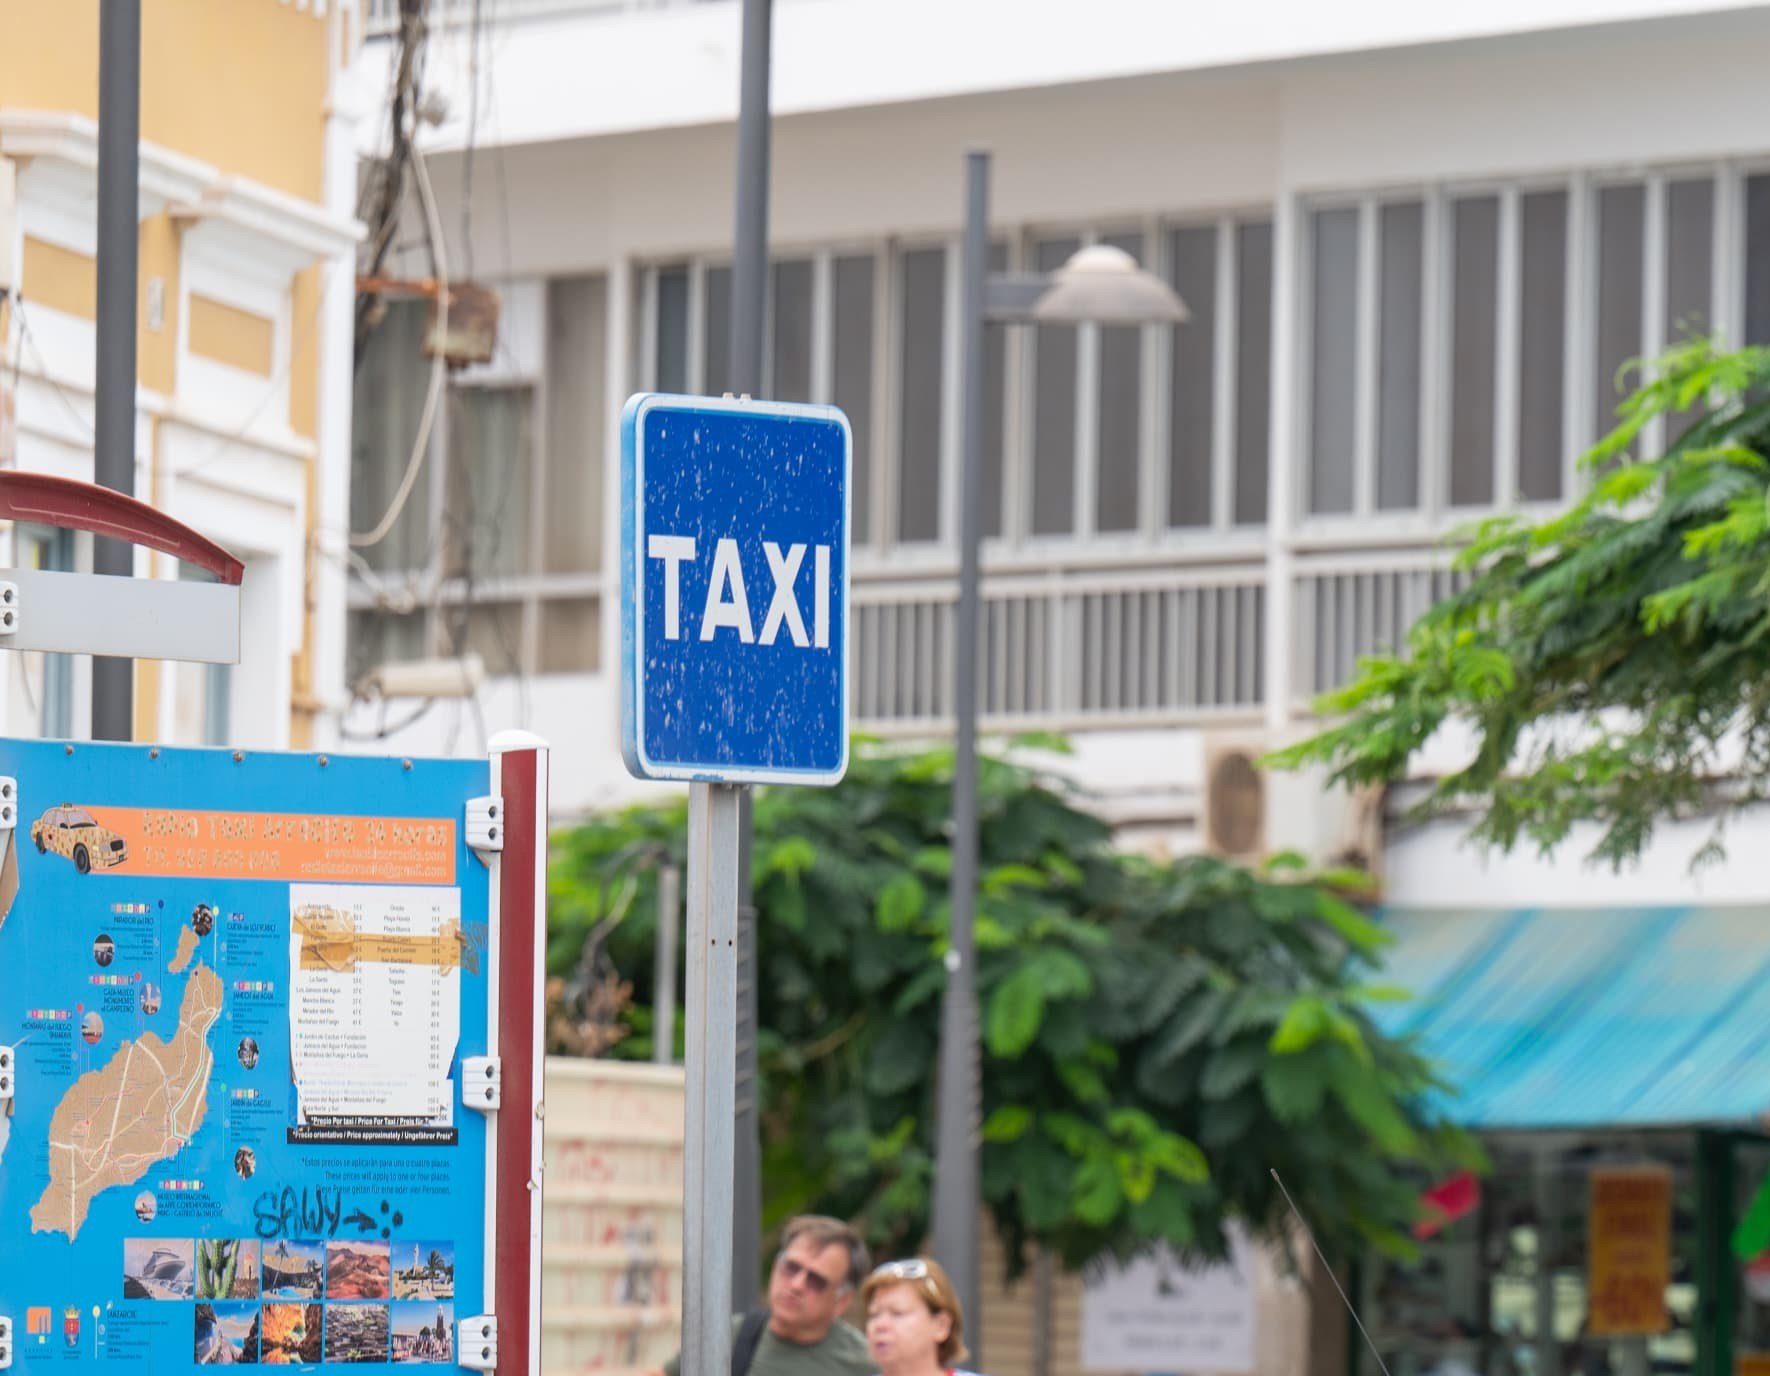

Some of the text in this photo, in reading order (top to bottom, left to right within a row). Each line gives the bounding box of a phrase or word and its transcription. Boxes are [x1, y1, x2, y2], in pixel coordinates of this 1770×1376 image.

[648, 534, 831, 649] TAXI
[347, 1130, 362, 1139] Price
[362, 1130, 400, 1141] approximately
